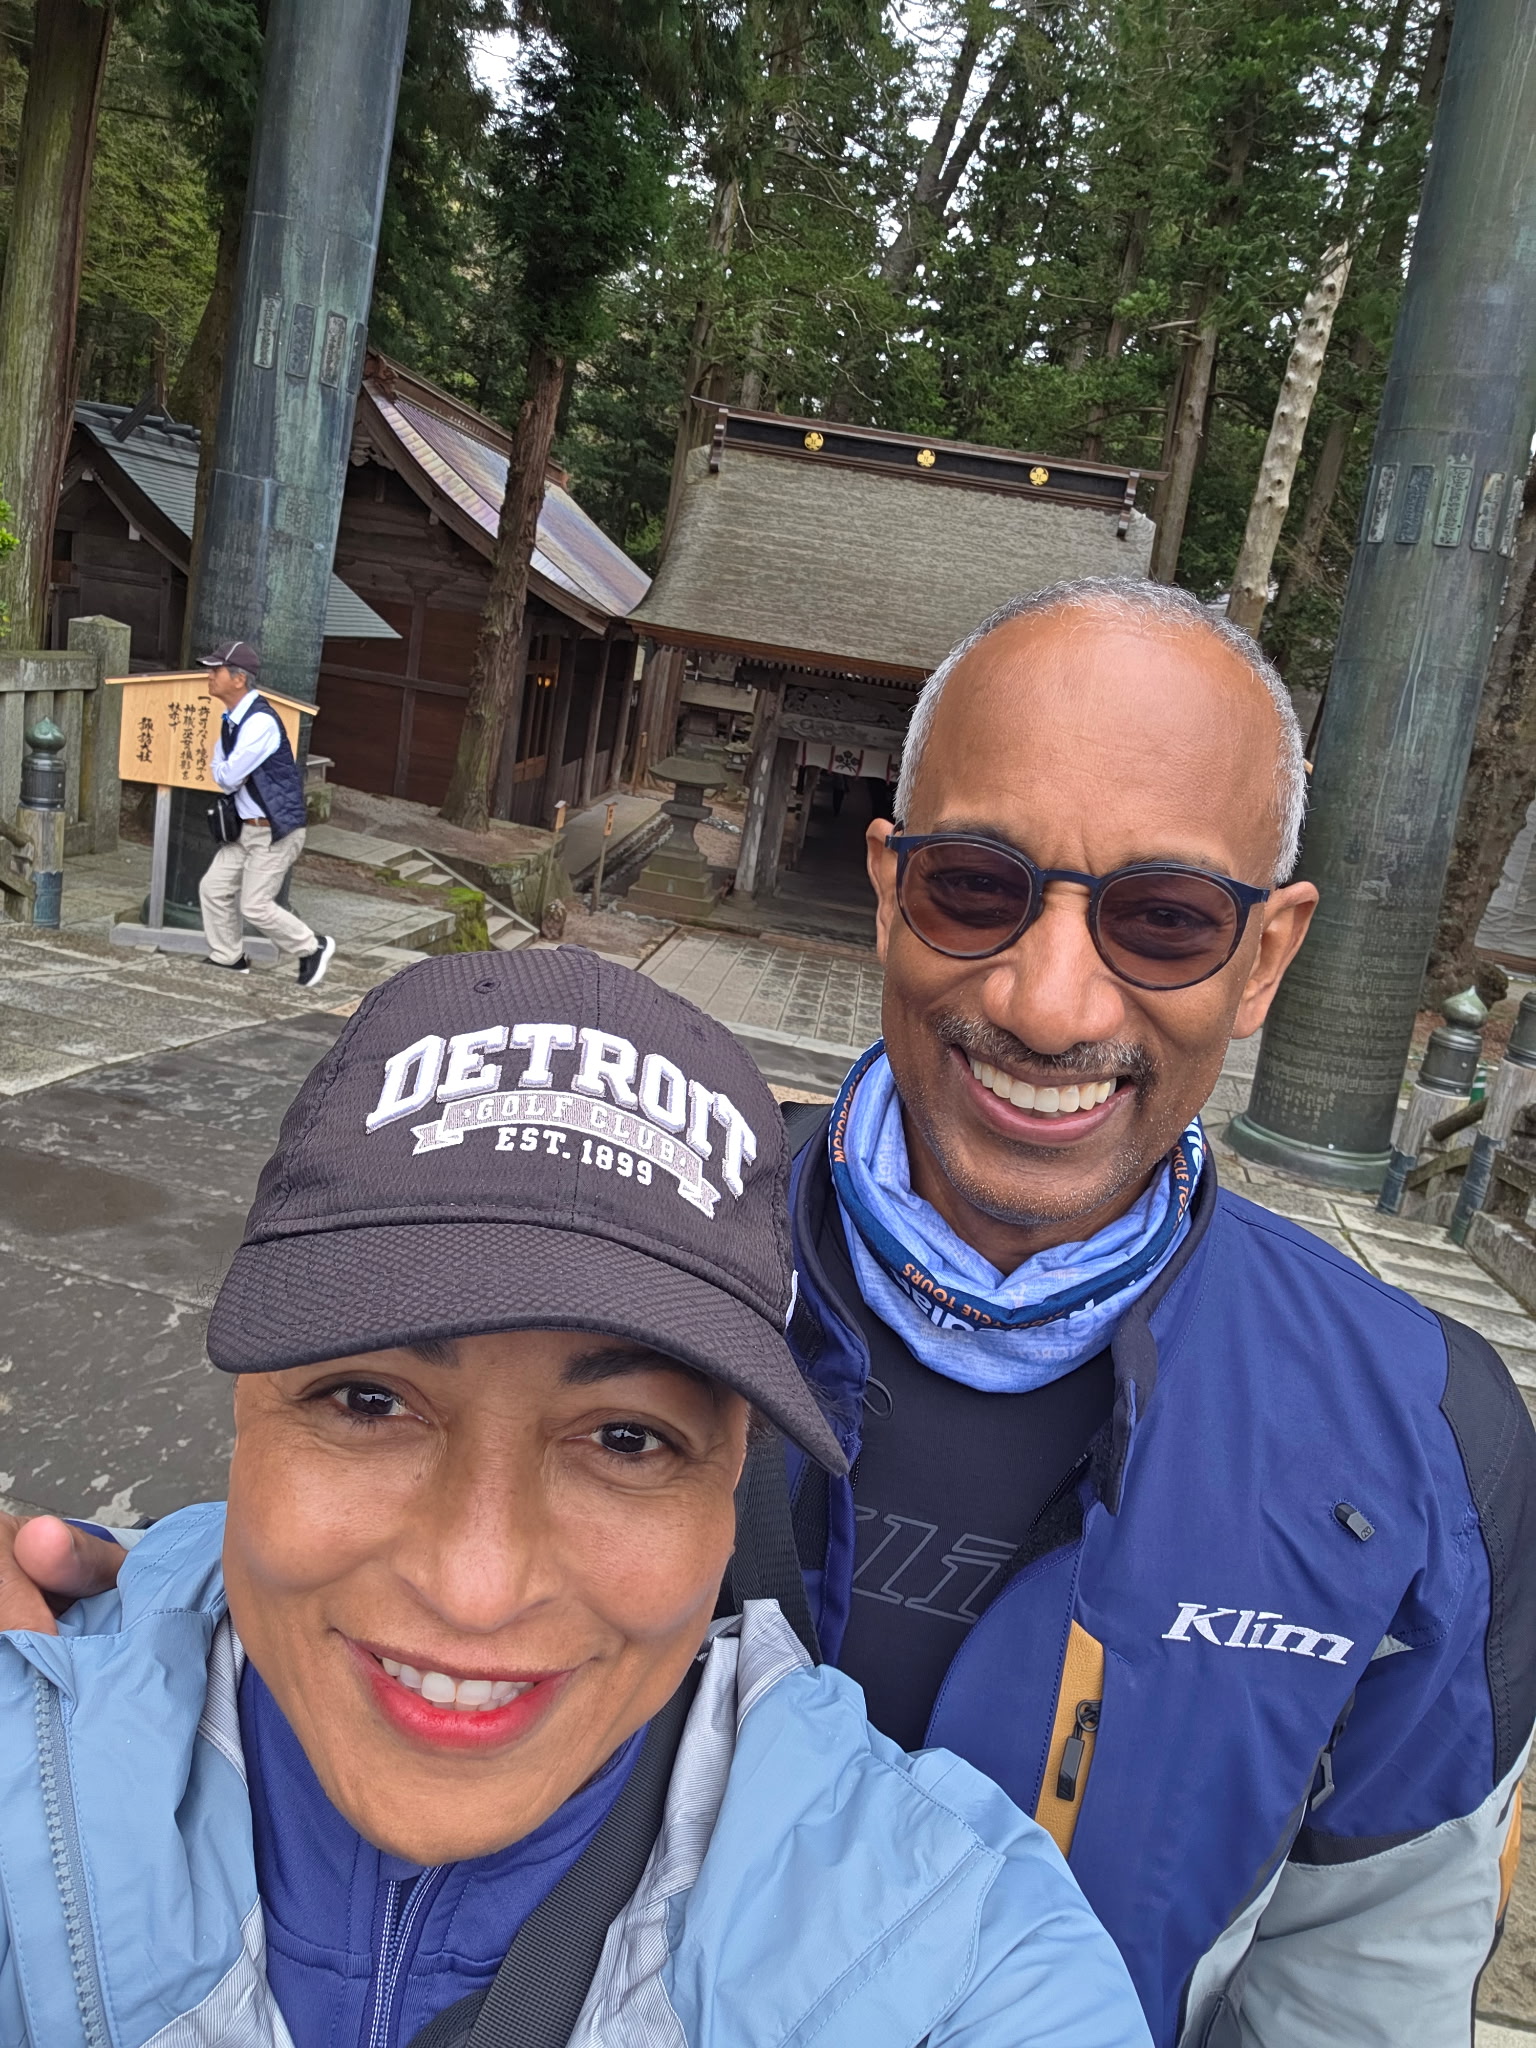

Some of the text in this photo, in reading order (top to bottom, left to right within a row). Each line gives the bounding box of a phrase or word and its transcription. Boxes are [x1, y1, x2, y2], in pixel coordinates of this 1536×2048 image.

[136, 716, 154, 764] 諏訪大社
[365, 1023, 757, 1200] DETROIT
[476, 1094, 676, 1163] GOLF CLUB
[494, 1127, 653, 1186] EST. 1899
[903, 1263, 956, 1309] TOURS
[1161, 1602, 1355, 1665] Klim
